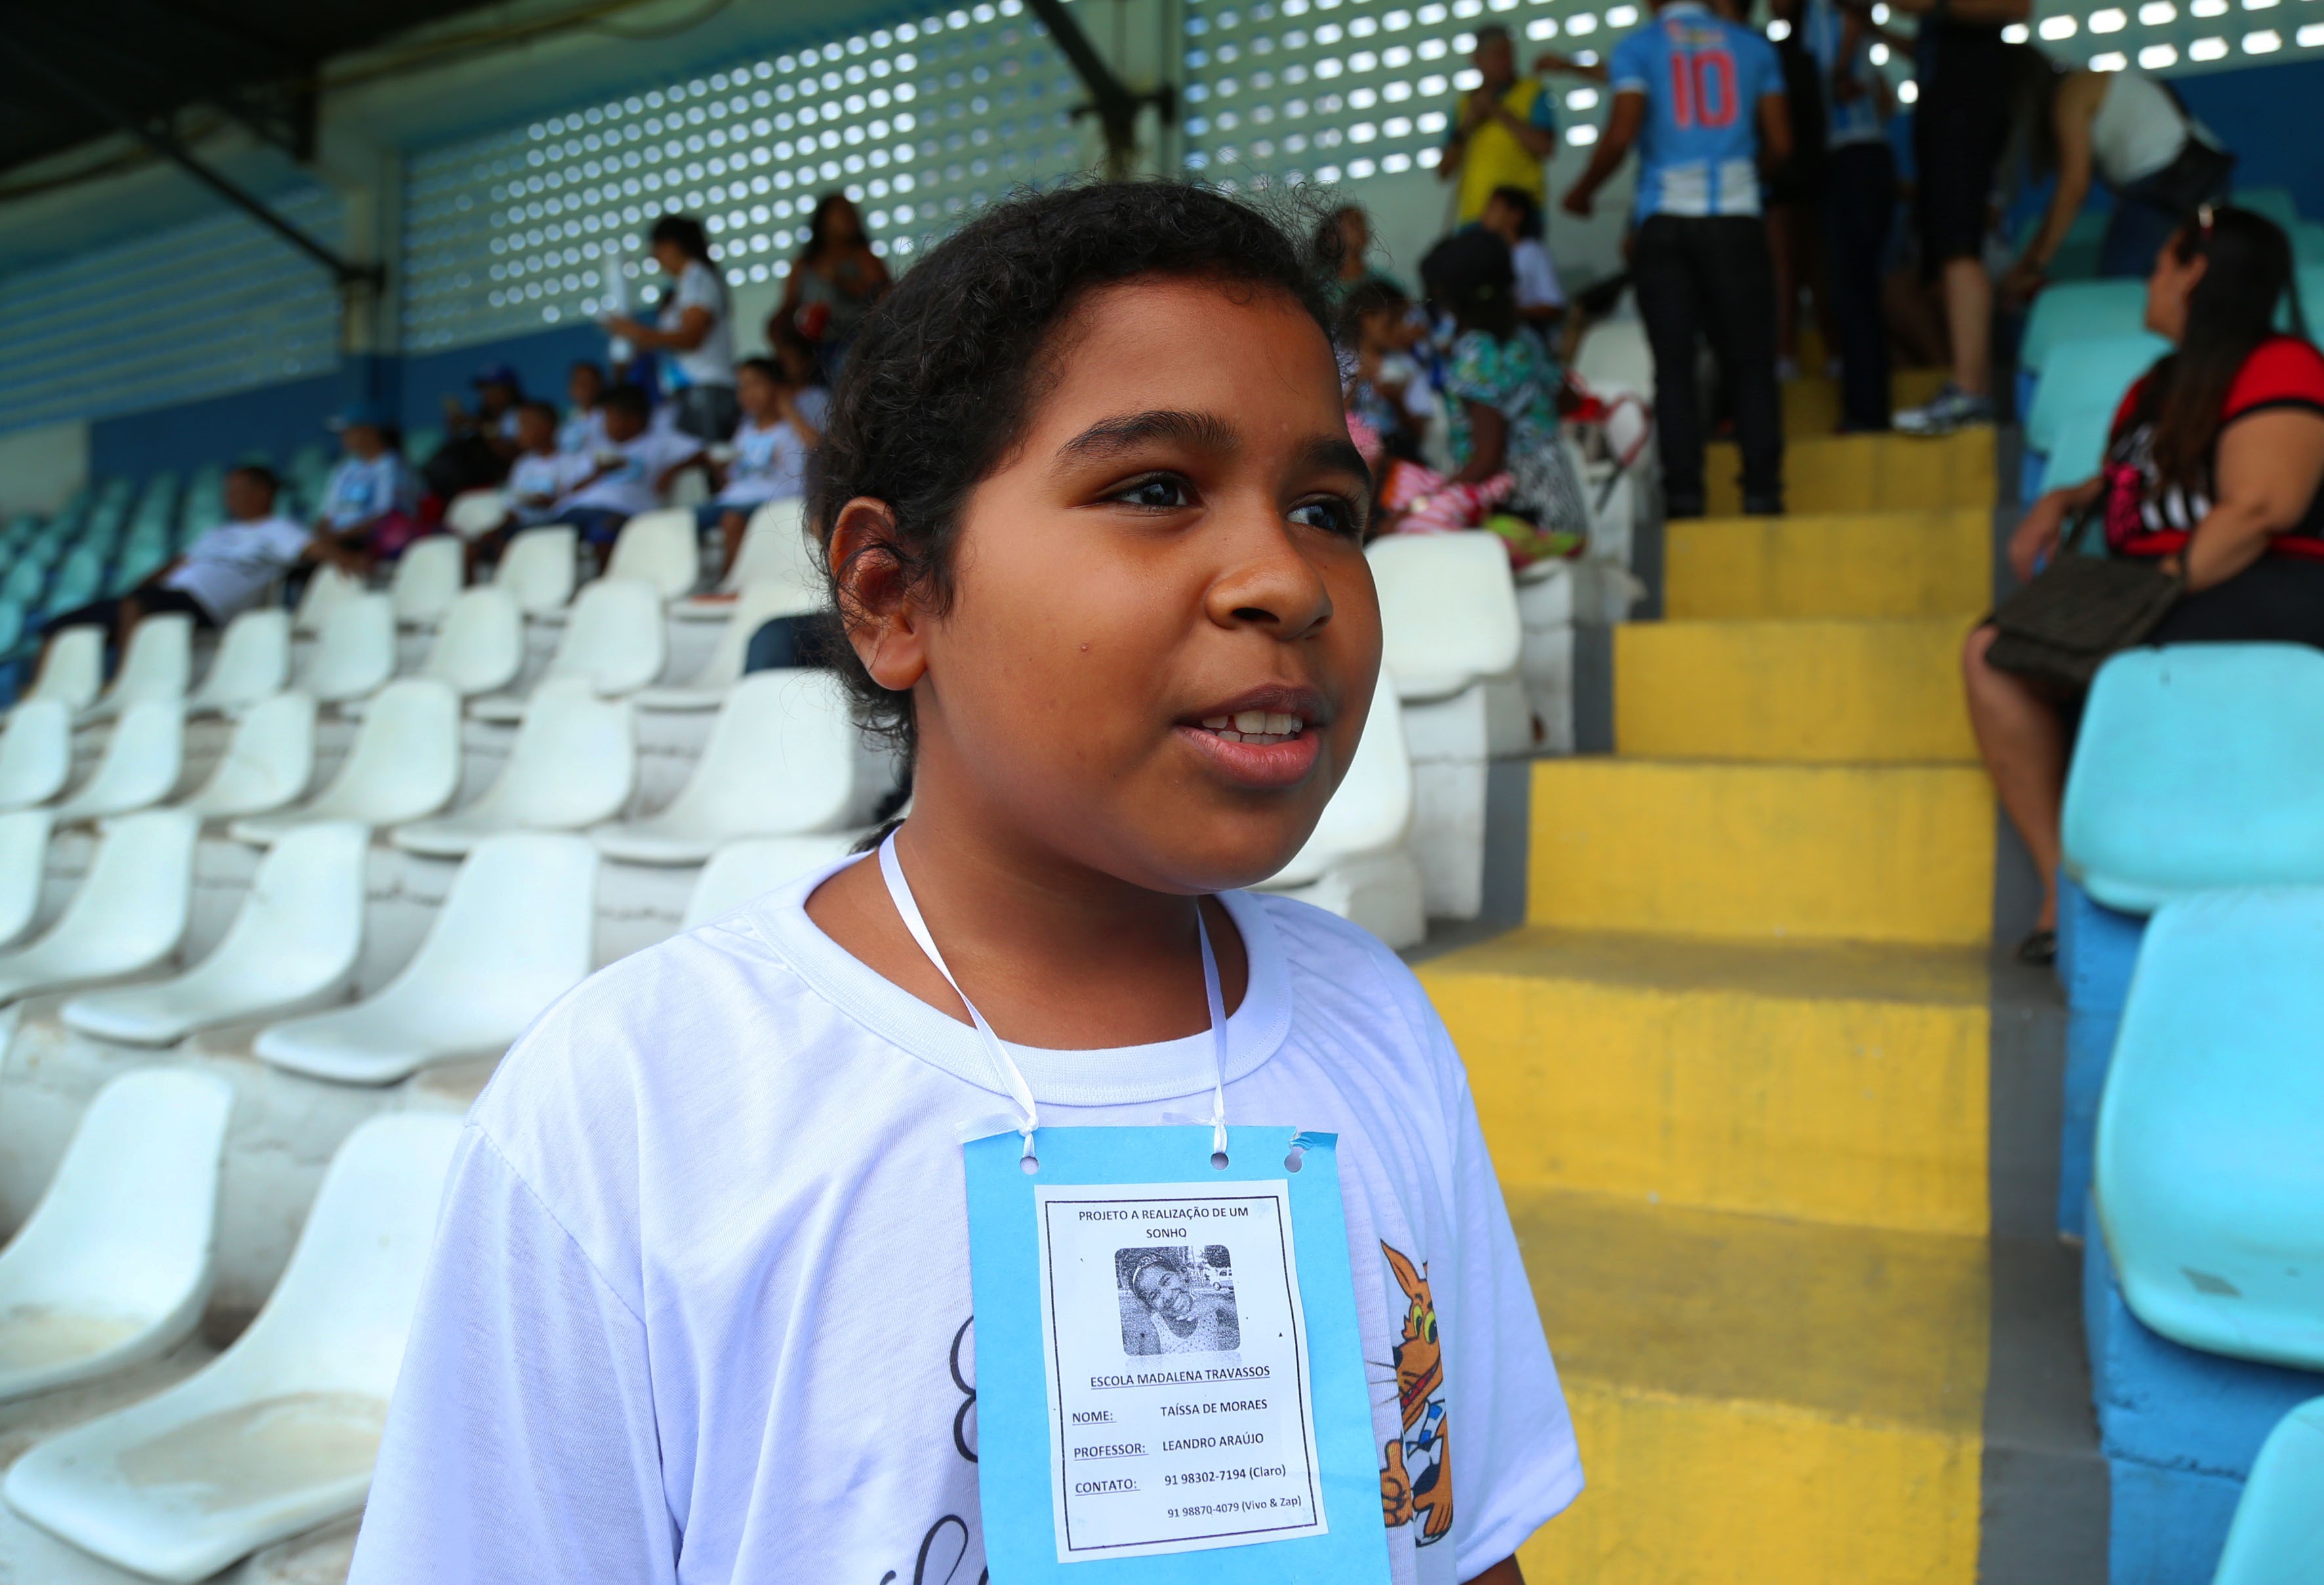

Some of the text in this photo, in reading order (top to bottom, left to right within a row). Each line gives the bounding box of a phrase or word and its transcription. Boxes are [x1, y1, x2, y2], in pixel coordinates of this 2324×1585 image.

[1670, 49, 1740, 130] 10
[1079, 1207, 1248, 1221] PROJETO A REALIZAÇÃO DE UM
[1146, 1228, 1187, 1239] SONHO
[1091, 1365, 1270, 1388] ESCOLA MADALENA TRAVASSOS
[1160, 1399, 1267, 1416] TAÍSSA DE MORAES
[1072, 1411, 1113, 1423] NOME:
[1163, 1432, 1264, 1451] LEANDRO ARAÚJO
[1074, 1443, 1145, 1458] PROFESSOR:
[1165, 1464, 1286, 1486] 91 98302-7194 (Claro)
[1075, 1478, 1137, 1494] CONTATO:
[1168, 1495, 1301, 1518] 91 98870-4079 (Vivo & Zap)
